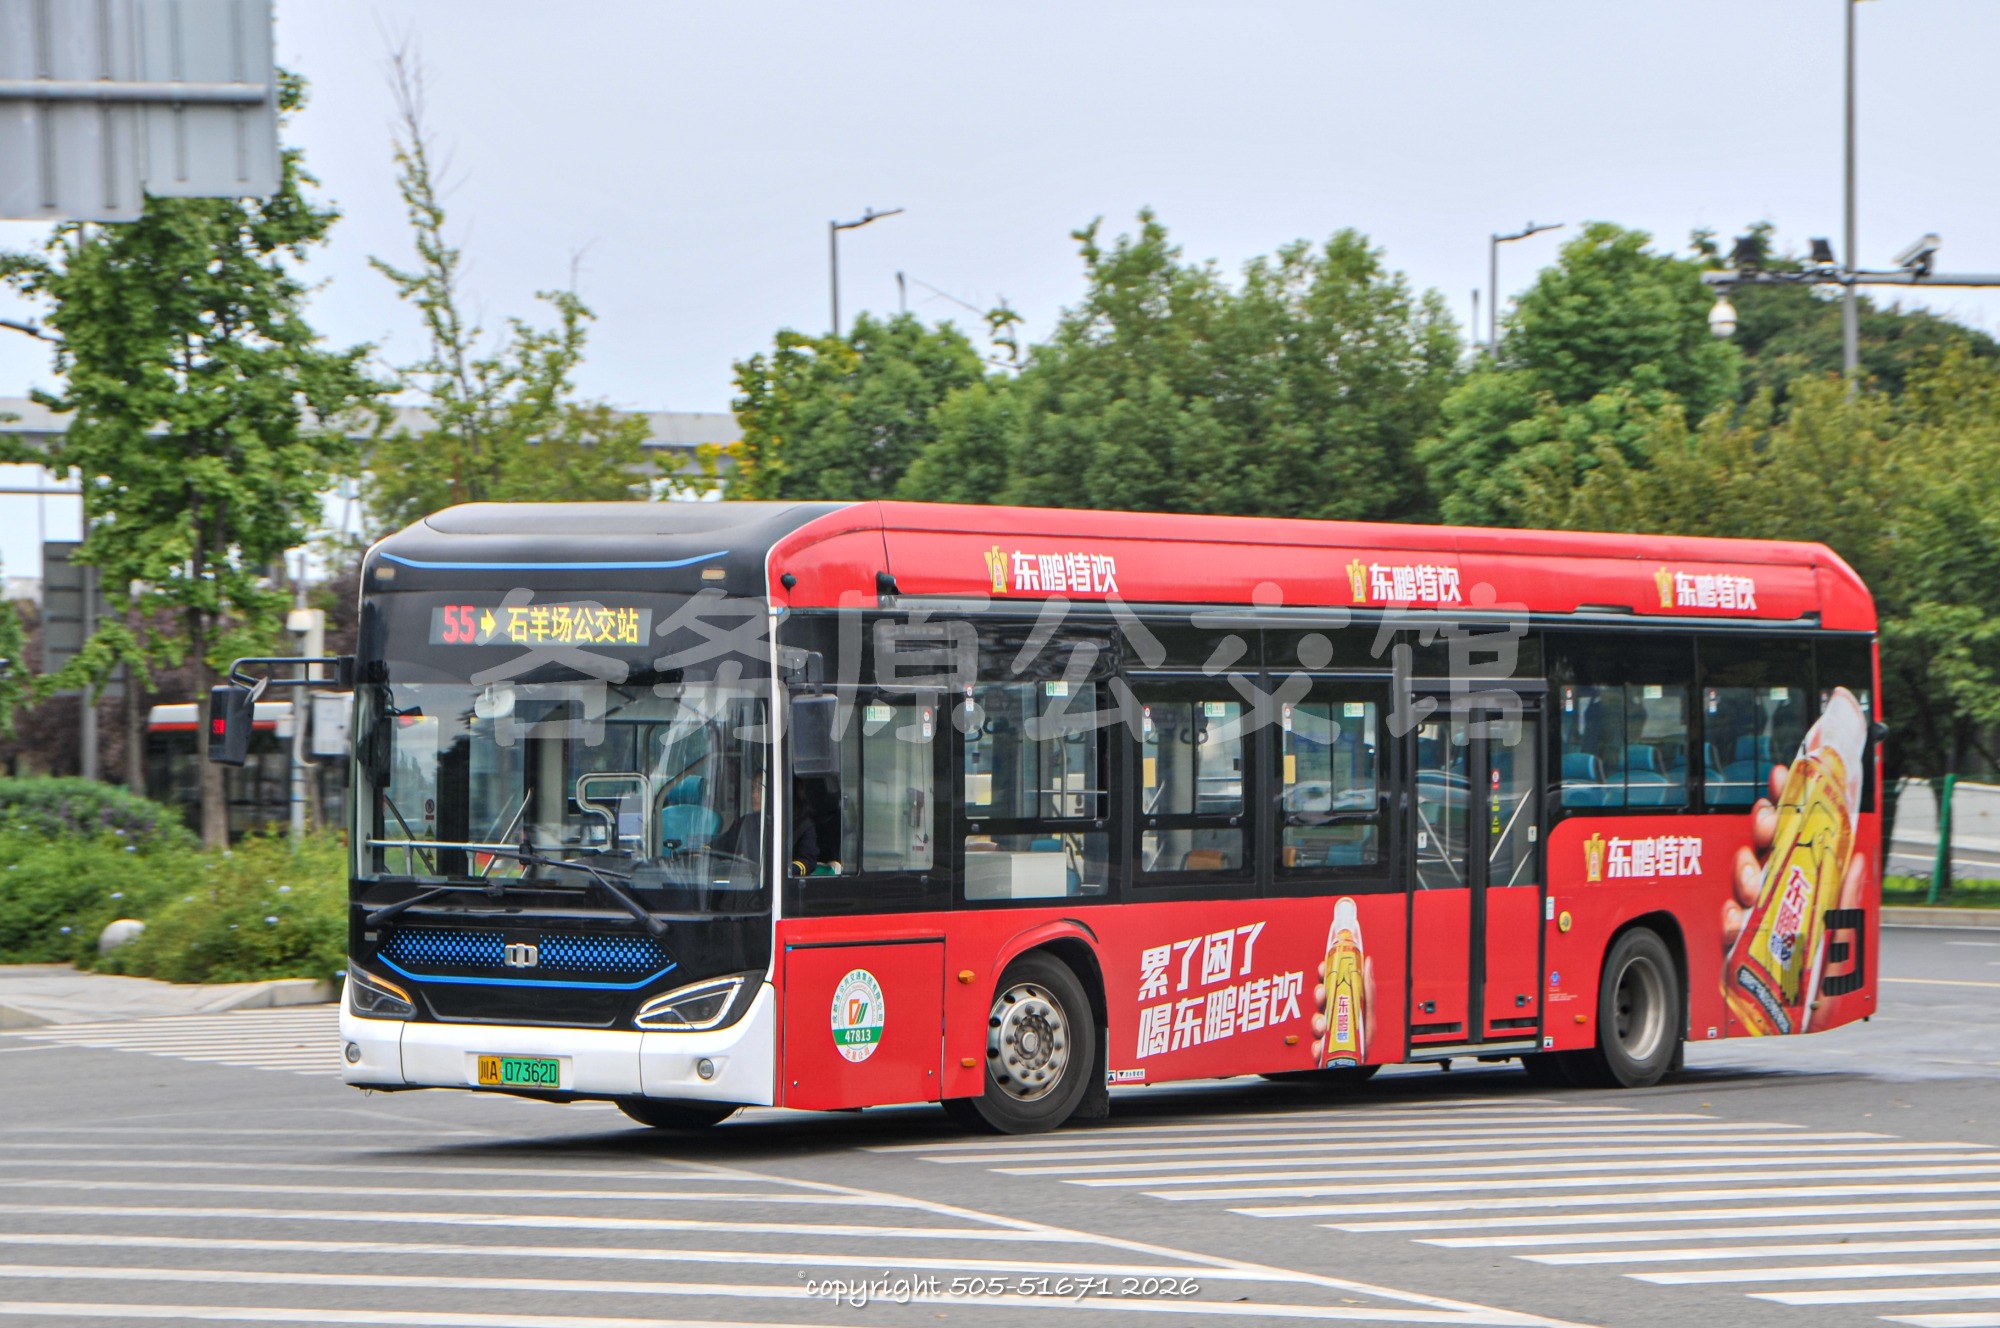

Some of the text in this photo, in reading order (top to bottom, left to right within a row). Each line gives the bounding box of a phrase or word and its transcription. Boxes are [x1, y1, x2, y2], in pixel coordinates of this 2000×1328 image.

[1010, 549, 1119, 593] 东鹏特饮
[1368, 562, 1462, 602] 东鹏特饮
[1674, 571, 1757, 611] 东鹏特饮
[442, 605, 639, 643] 55 石羊场公交站
[1607, 836, 1702, 878] 东鹏特饮
[1138, 921, 1267, 1001] 累了困了
[1136, 971, 1304, 1059] 喝东鹏特饮
[845, 1029, 871, 1043] 47813
